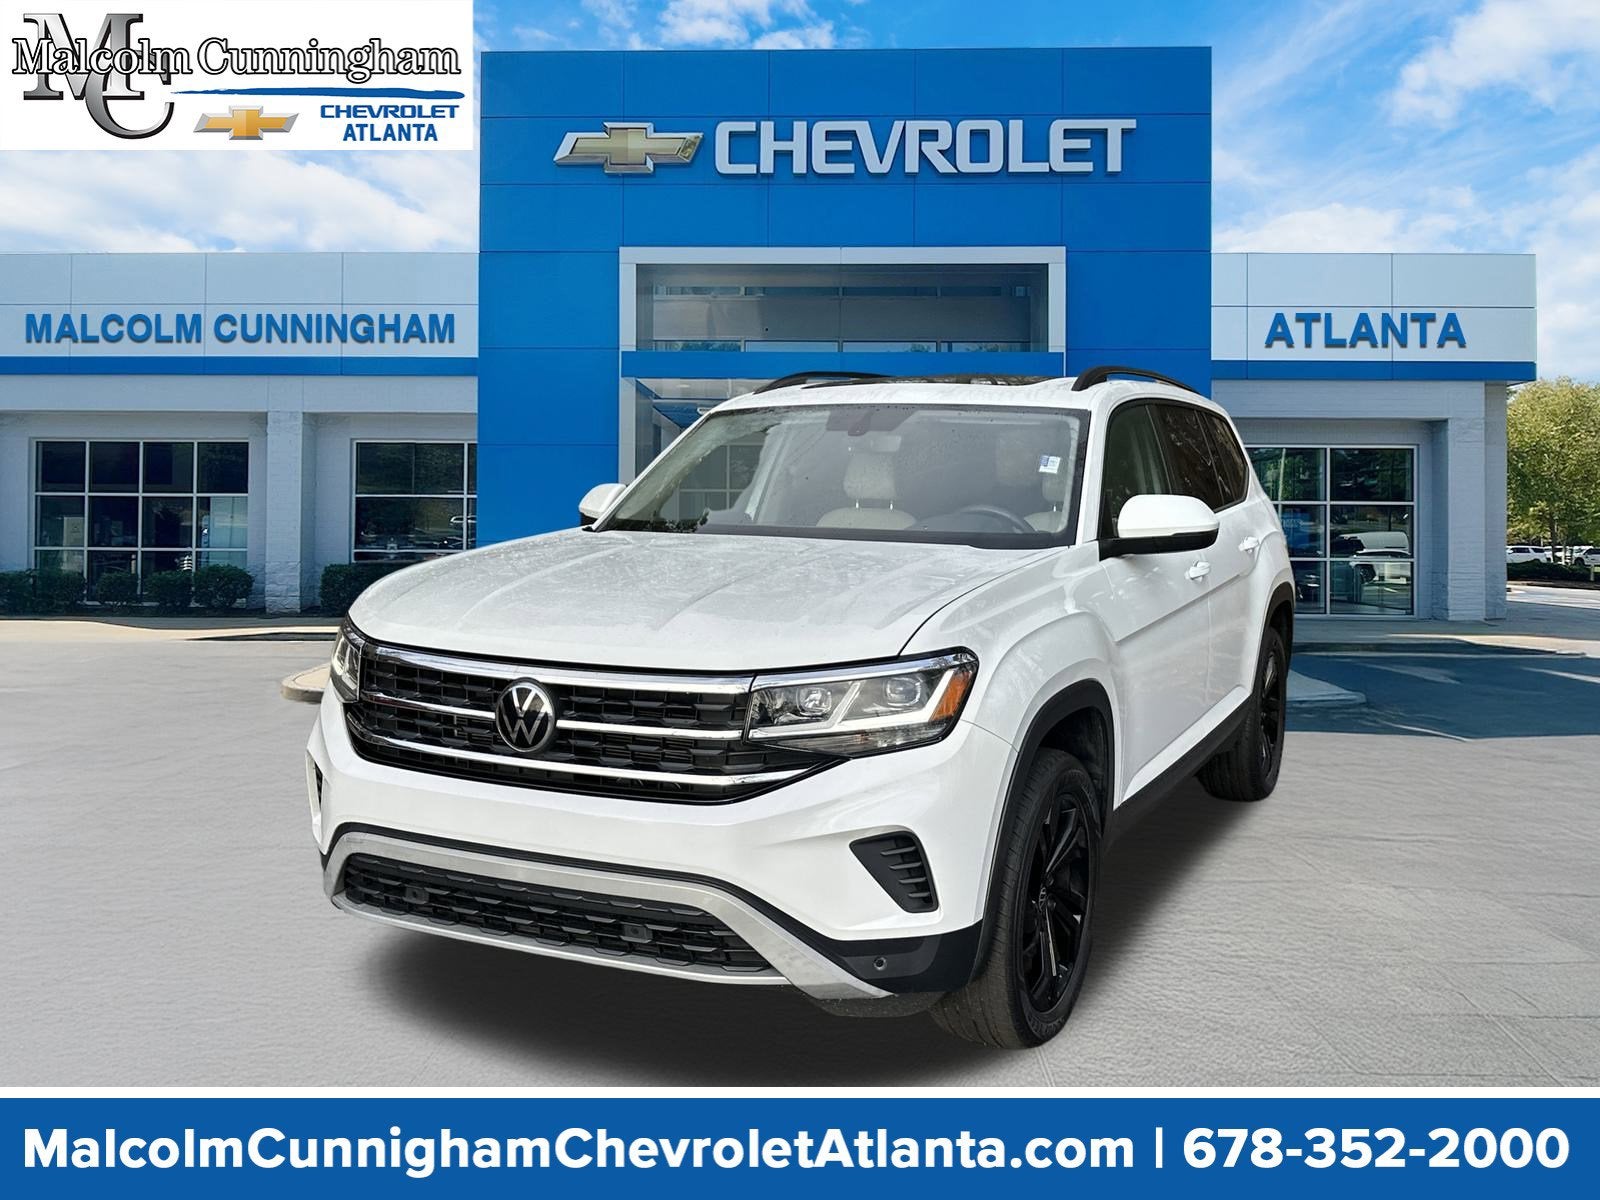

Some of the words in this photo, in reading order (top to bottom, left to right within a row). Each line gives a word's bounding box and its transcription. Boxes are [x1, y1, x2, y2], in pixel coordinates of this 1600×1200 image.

[715, 119, 1137, 175] CHEVROLET
[25, 313, 202, 344] MALCOLM
[213, 313, 456, 344] CUNNINGHAM
[1264, 312, 1467, 349] ATLANTA
